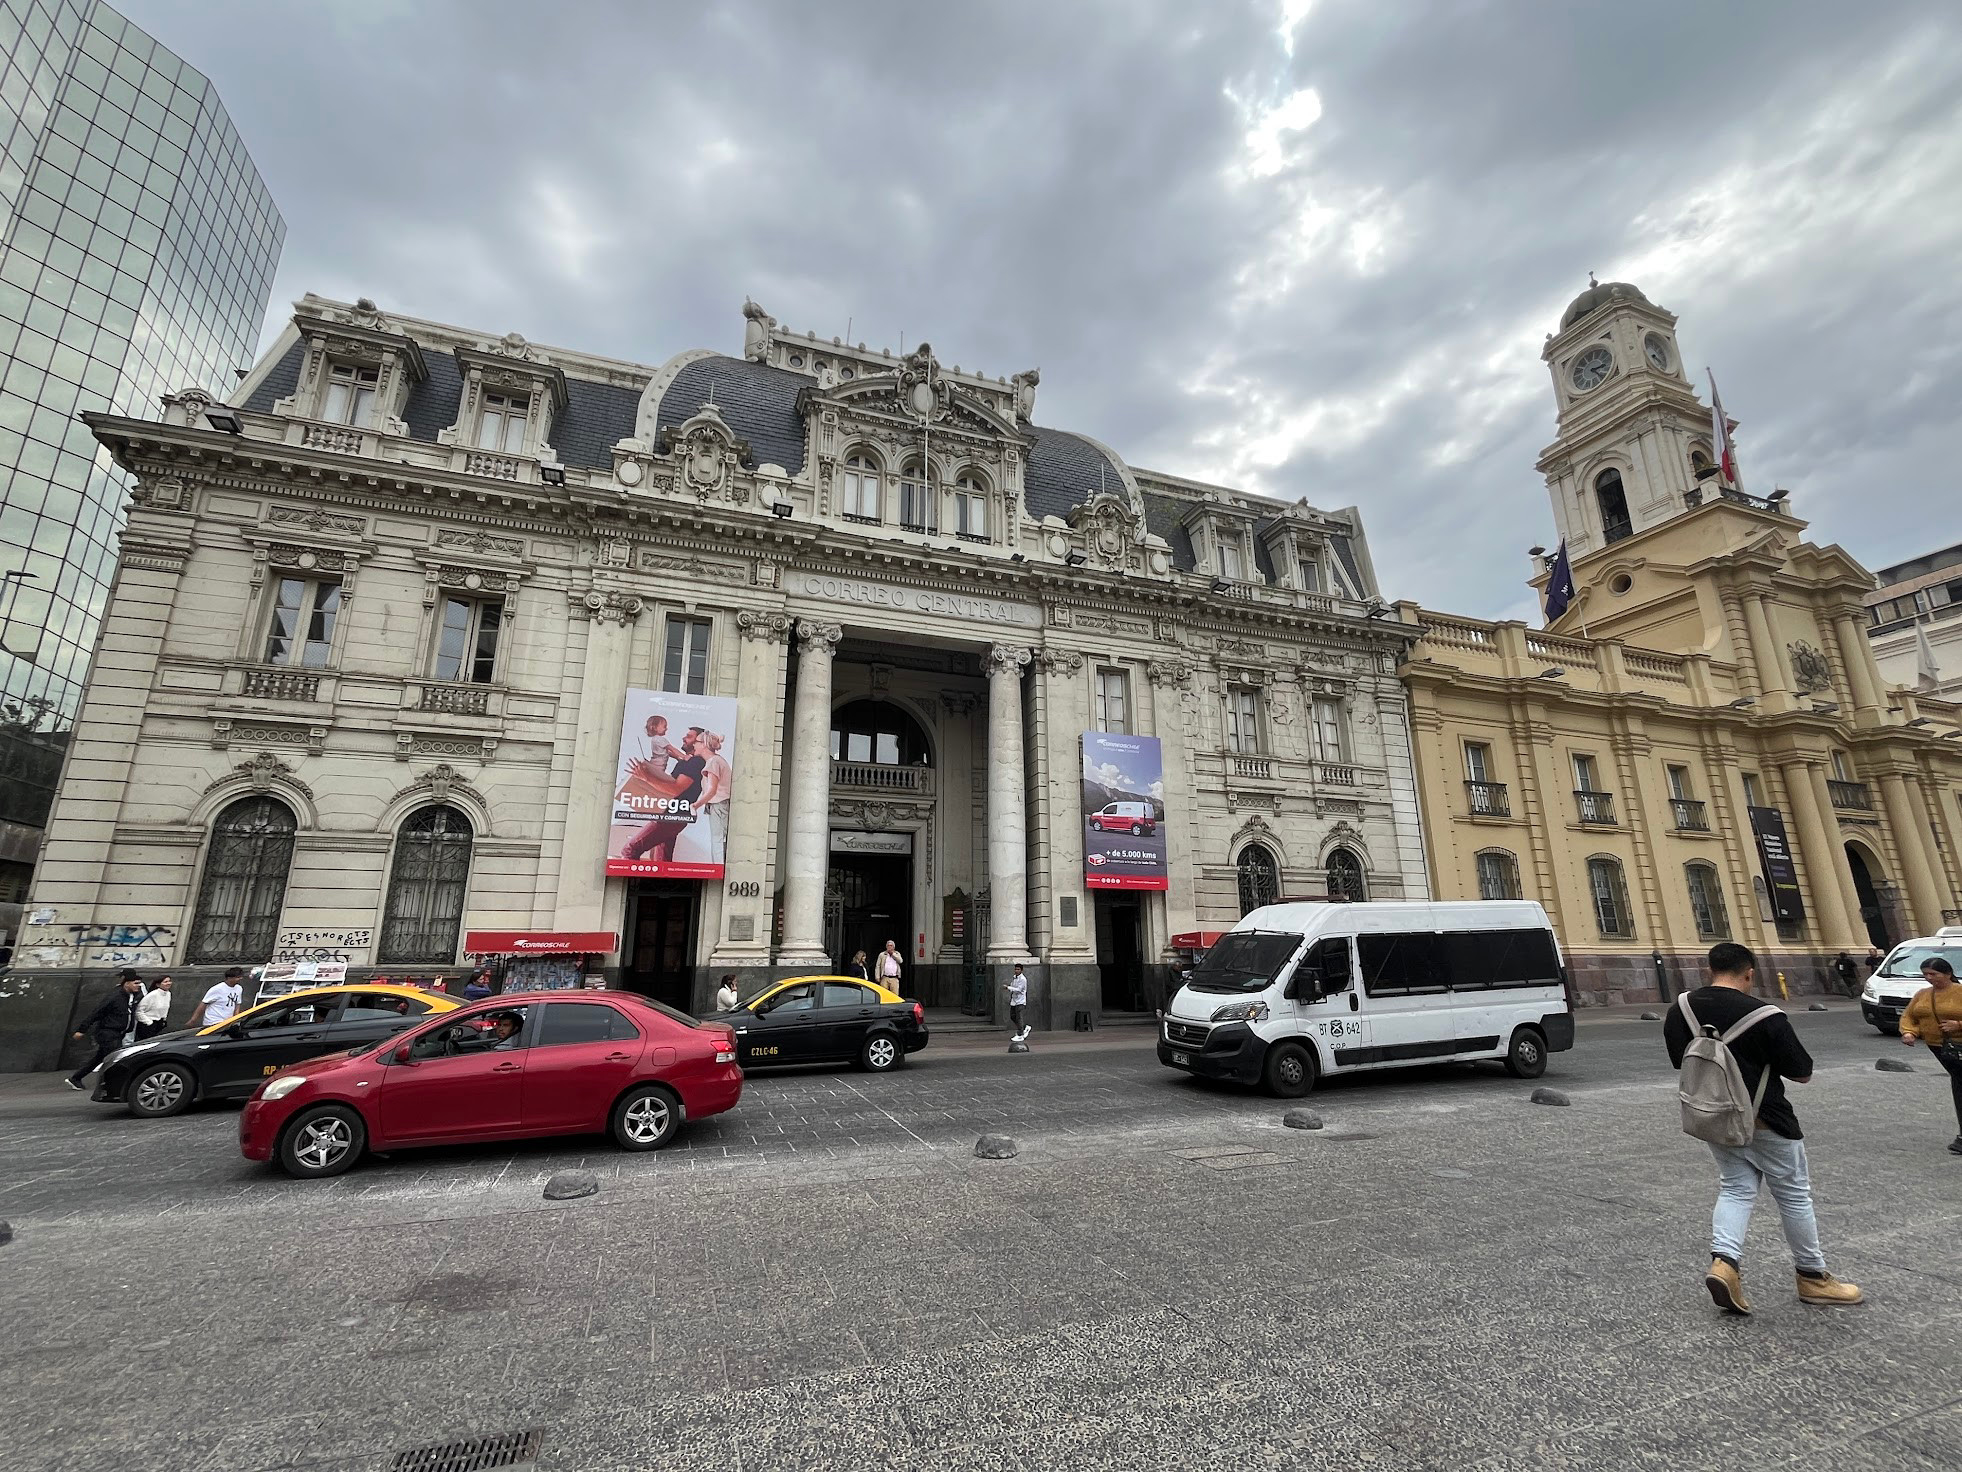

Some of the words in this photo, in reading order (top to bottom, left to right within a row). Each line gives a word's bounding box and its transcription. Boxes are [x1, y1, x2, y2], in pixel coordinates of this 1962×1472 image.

[804, 578, 906, 607] CORREO
[915, 594, 1025, 623] CENTRAL
[620, 792, 690, 814] Entrega
[1112, 849, 1121, 857] de
[1122, 850, 1141, 858] 5.000
[1142, 851, 1157, 859] kms
[729, 881, 760, 897] 989
[1346, 1022, 1360, 1035] 642
